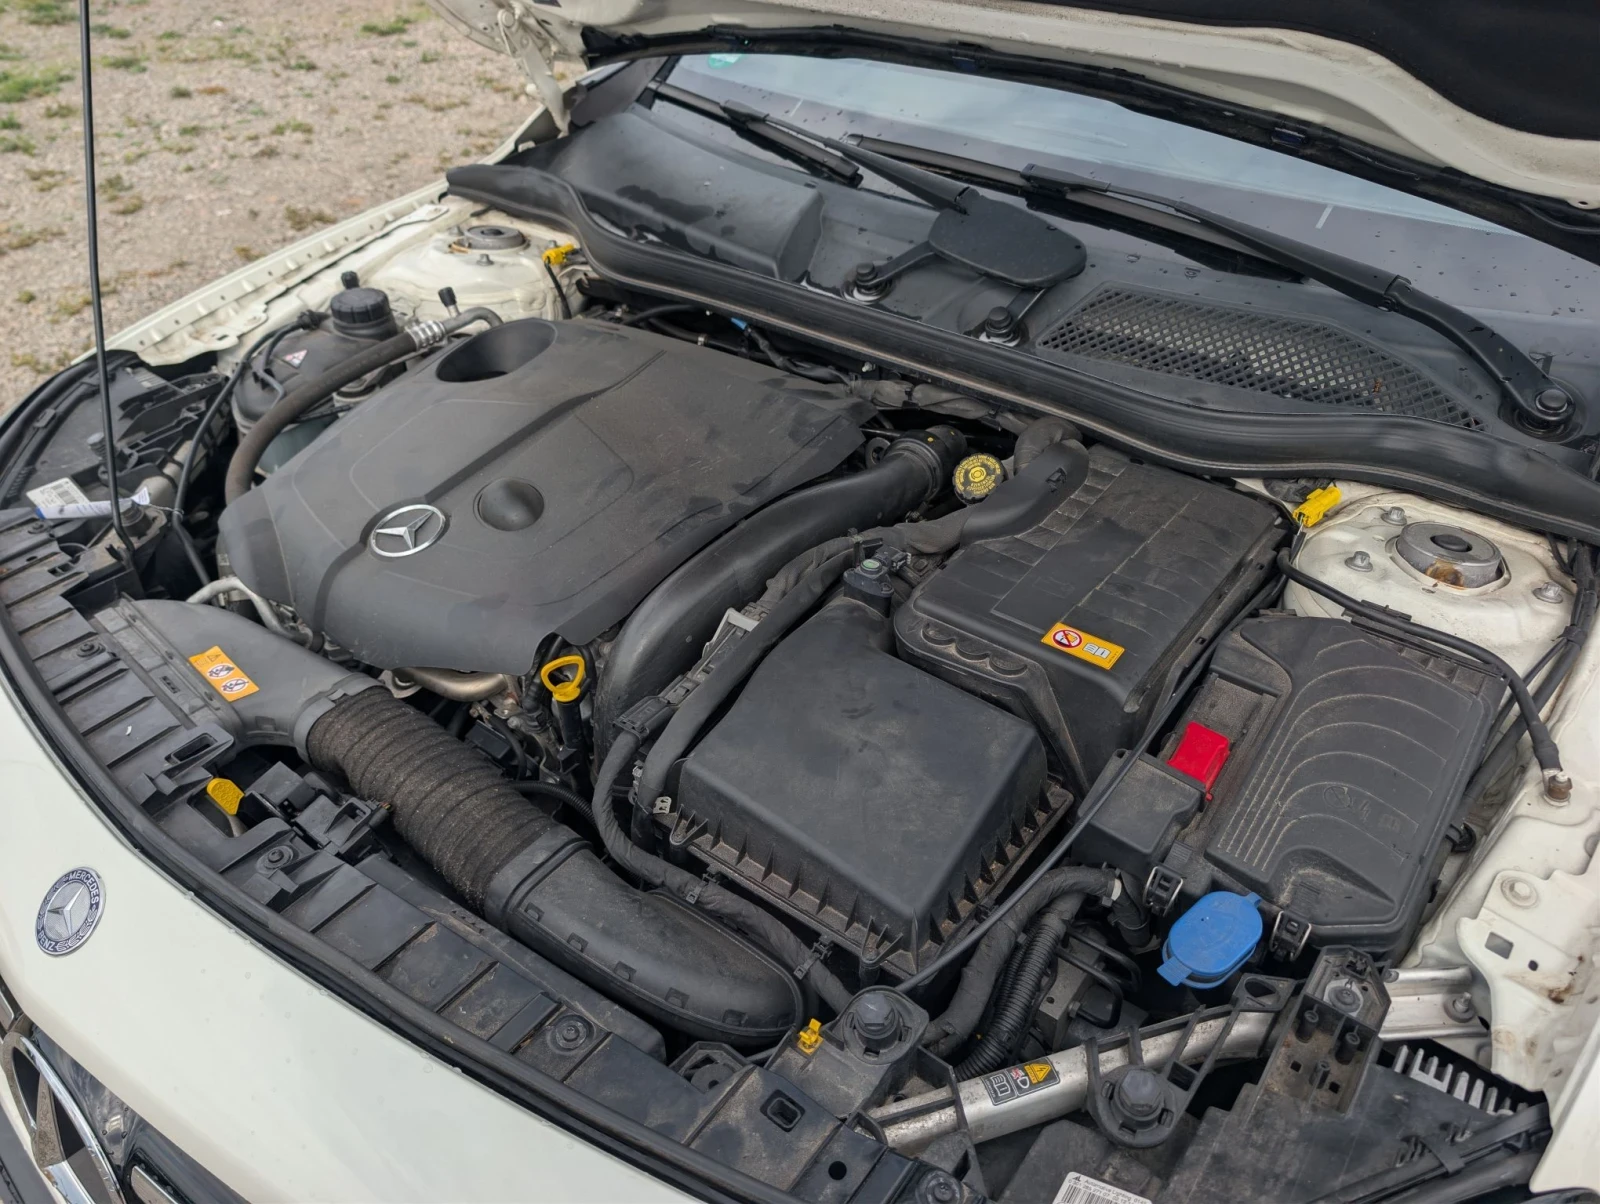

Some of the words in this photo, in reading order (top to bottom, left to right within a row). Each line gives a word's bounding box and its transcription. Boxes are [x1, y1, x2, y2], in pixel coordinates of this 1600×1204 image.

[68, 870, 99, 904] MERCEDES
[38, 932, 56, 951] BENZ
[1084, 1180, 1112, 1193] Automotive
